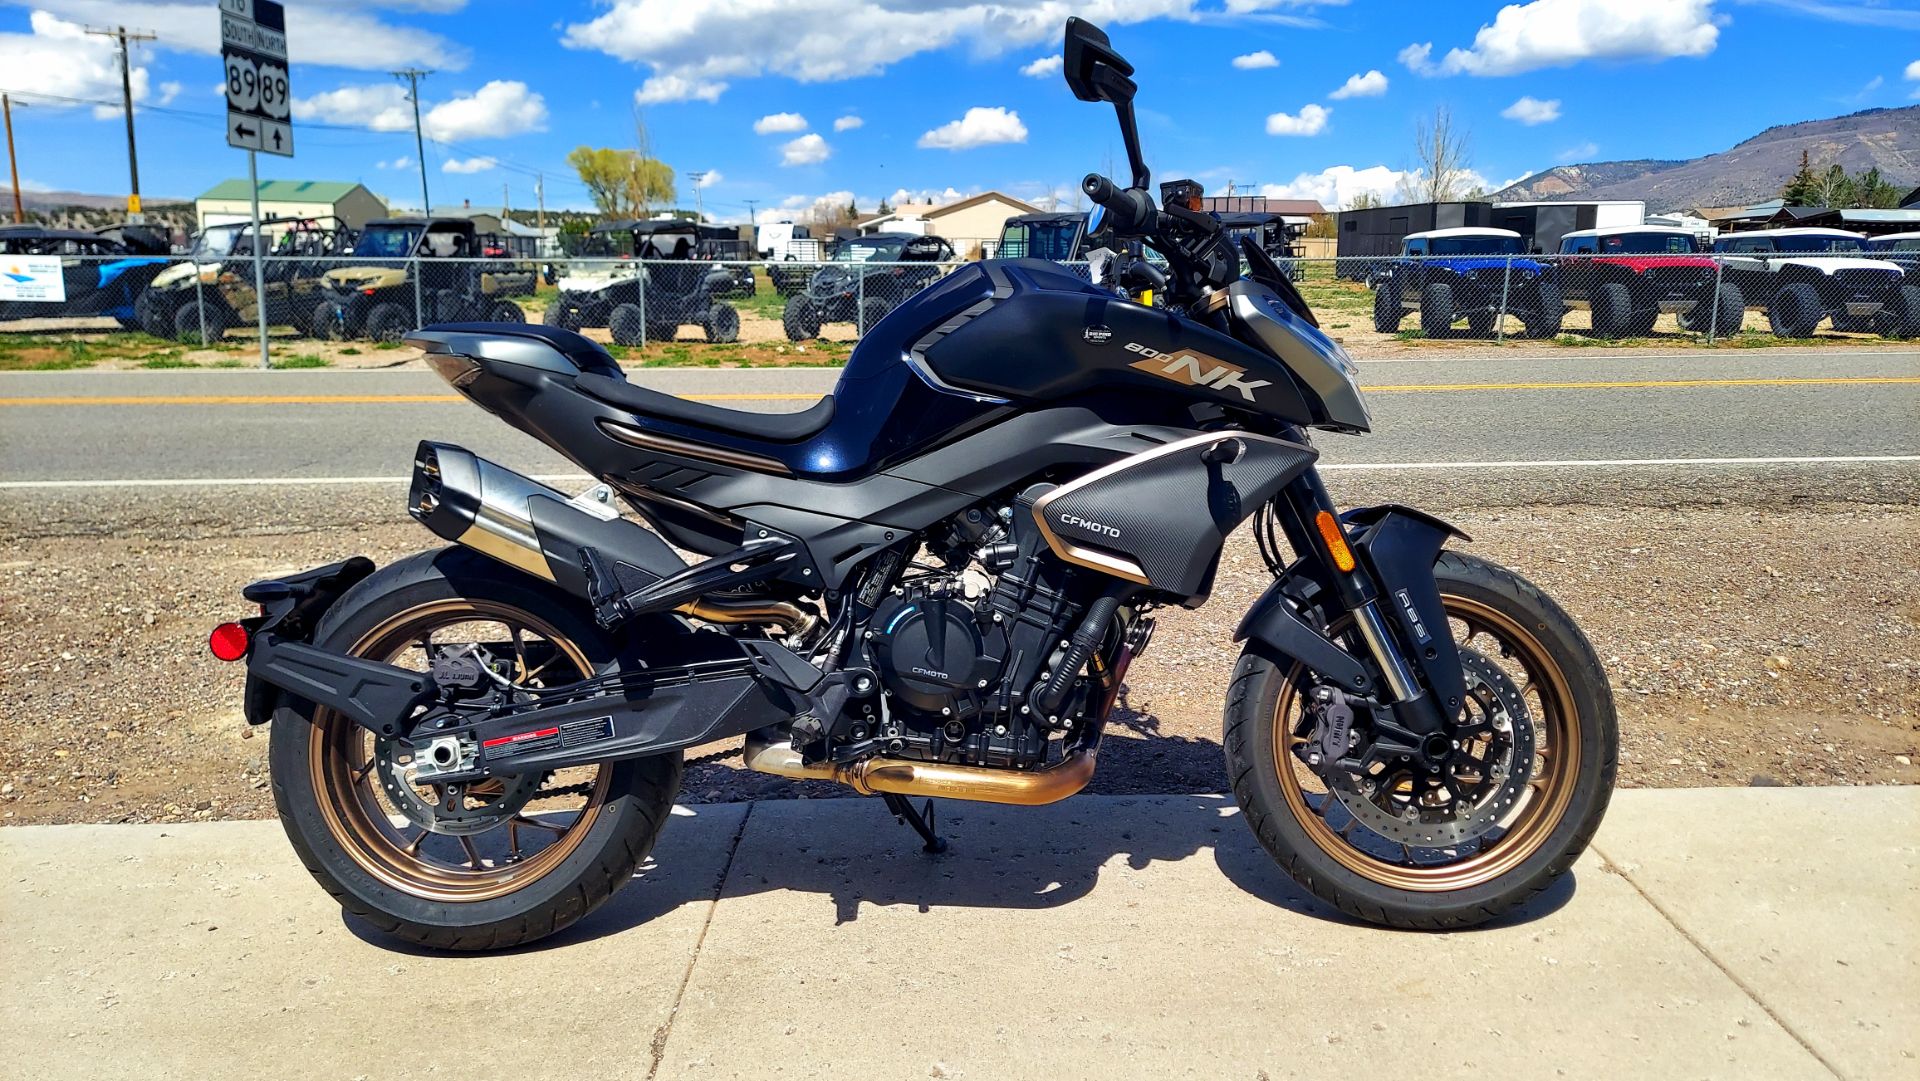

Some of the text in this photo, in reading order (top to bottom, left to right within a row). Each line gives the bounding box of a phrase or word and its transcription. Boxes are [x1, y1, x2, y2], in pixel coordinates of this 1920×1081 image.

[224, 20, 254, 43] SOUTH
[259, 32, 286, 54] NORTH
[229, 65, 255, 98] 89
[262, 75, 286, 105] 89
[1124, 342, 1273, 402] 800 NK
[1061, 513, 1121, 538] CFMOTO
[1399, 592, 1426, 638] ABS
[912, 667, 949, 680] CFMOTO
